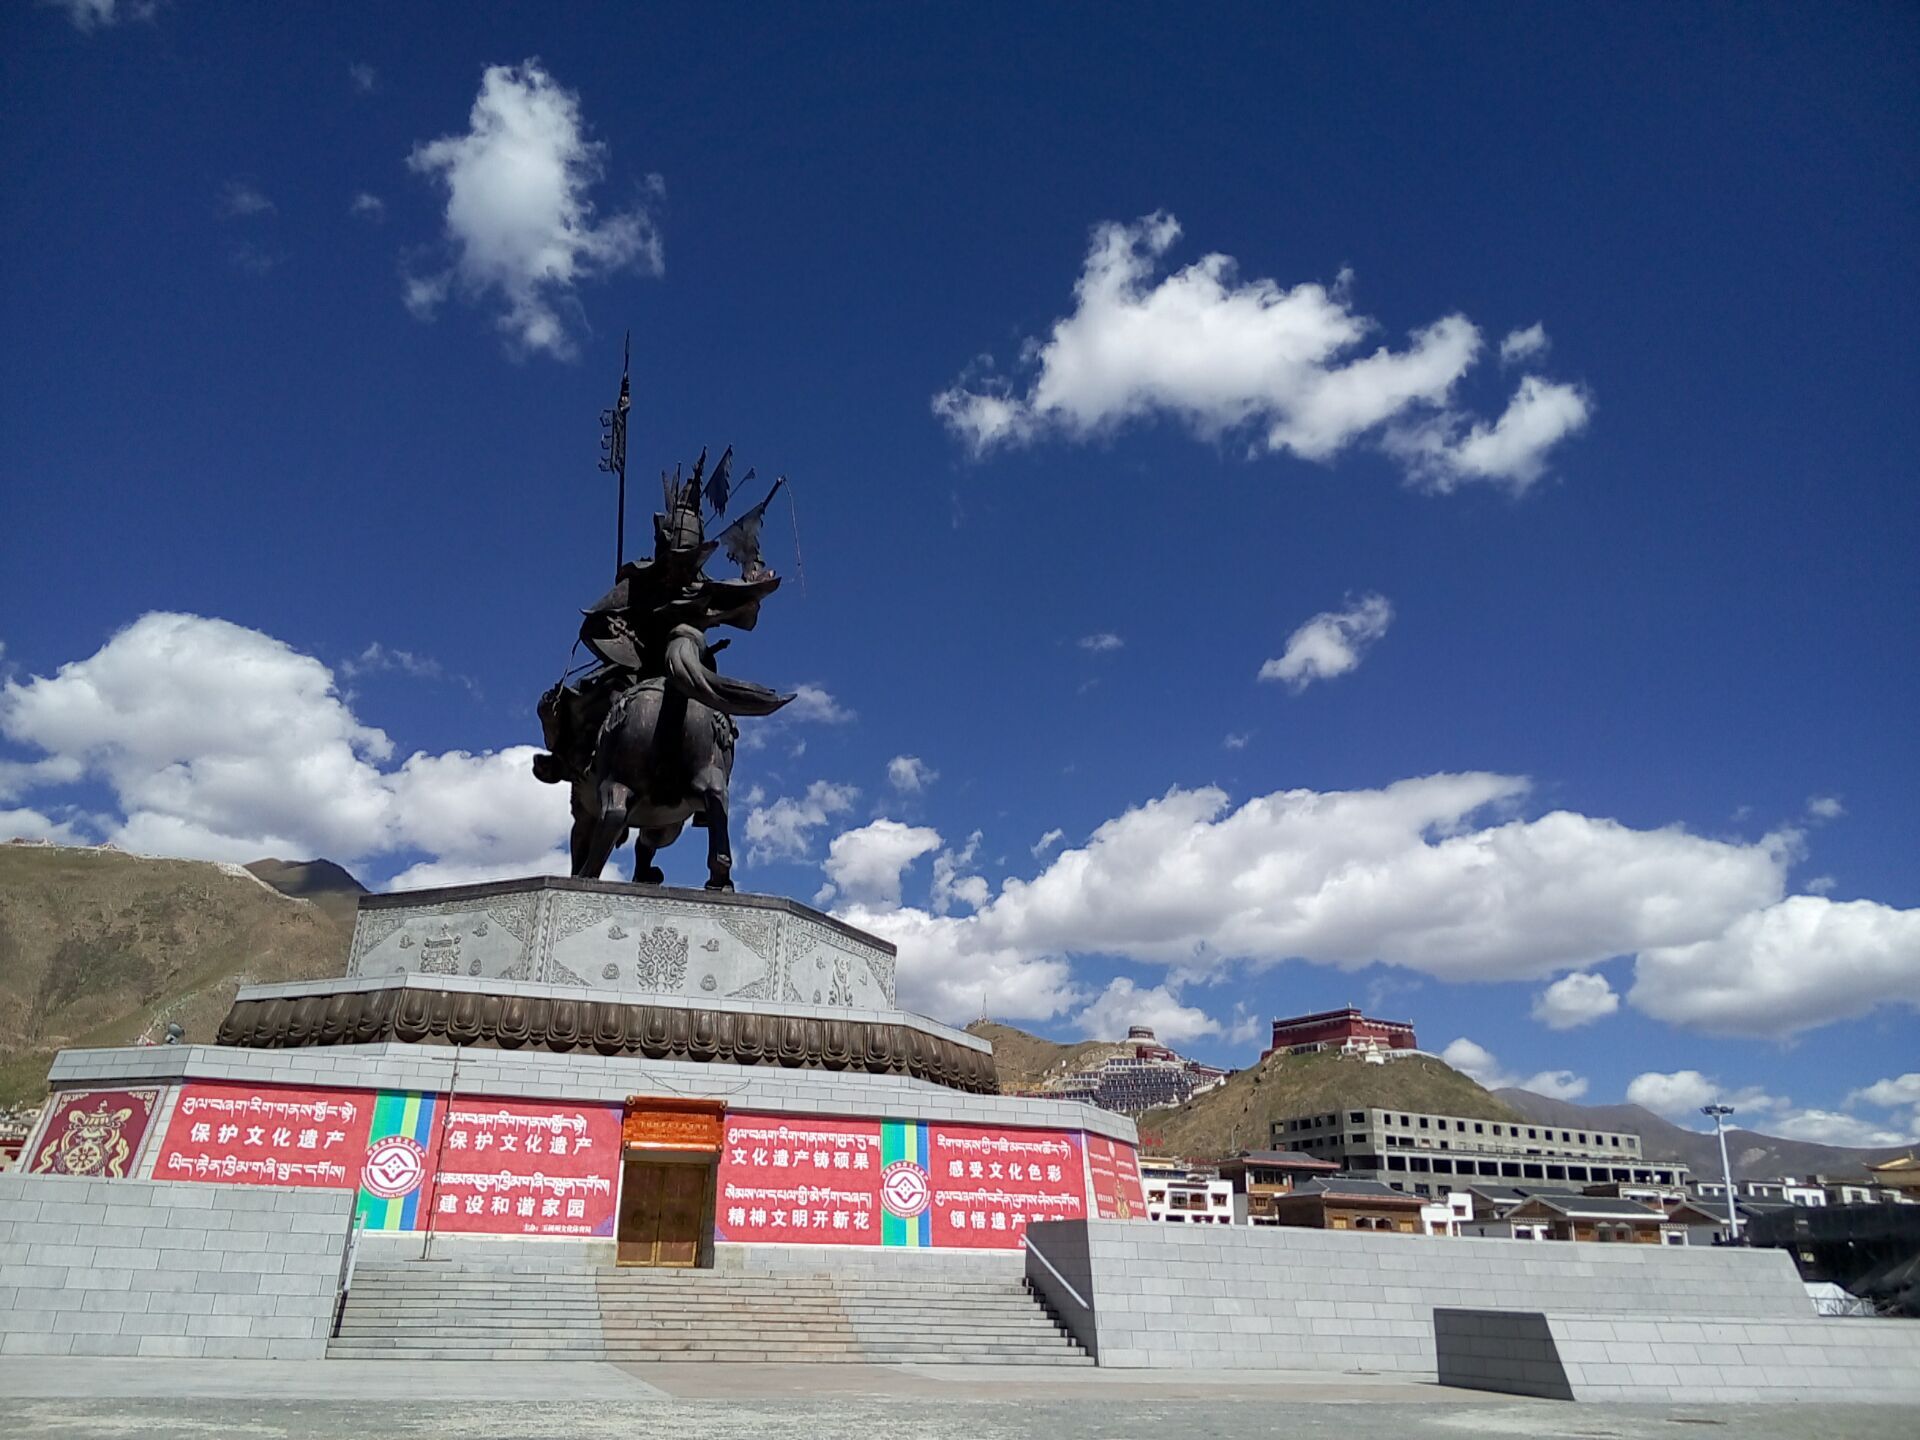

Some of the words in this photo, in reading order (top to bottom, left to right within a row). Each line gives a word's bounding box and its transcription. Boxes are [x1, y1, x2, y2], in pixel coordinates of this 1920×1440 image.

[191, 1122, 345, 1149] 保护文化遗产
[449, 1131, 592, 1155] 保护文化遗产
[732, 1147, 869, 1170] 文化遗产铸硕果
[949, 1160, 1062, 1182] 感受文化色彩
[438, 1194, 585, 1218] 建设和谐家园
[728, 1206, 869, 1229] 精神文明开新花
